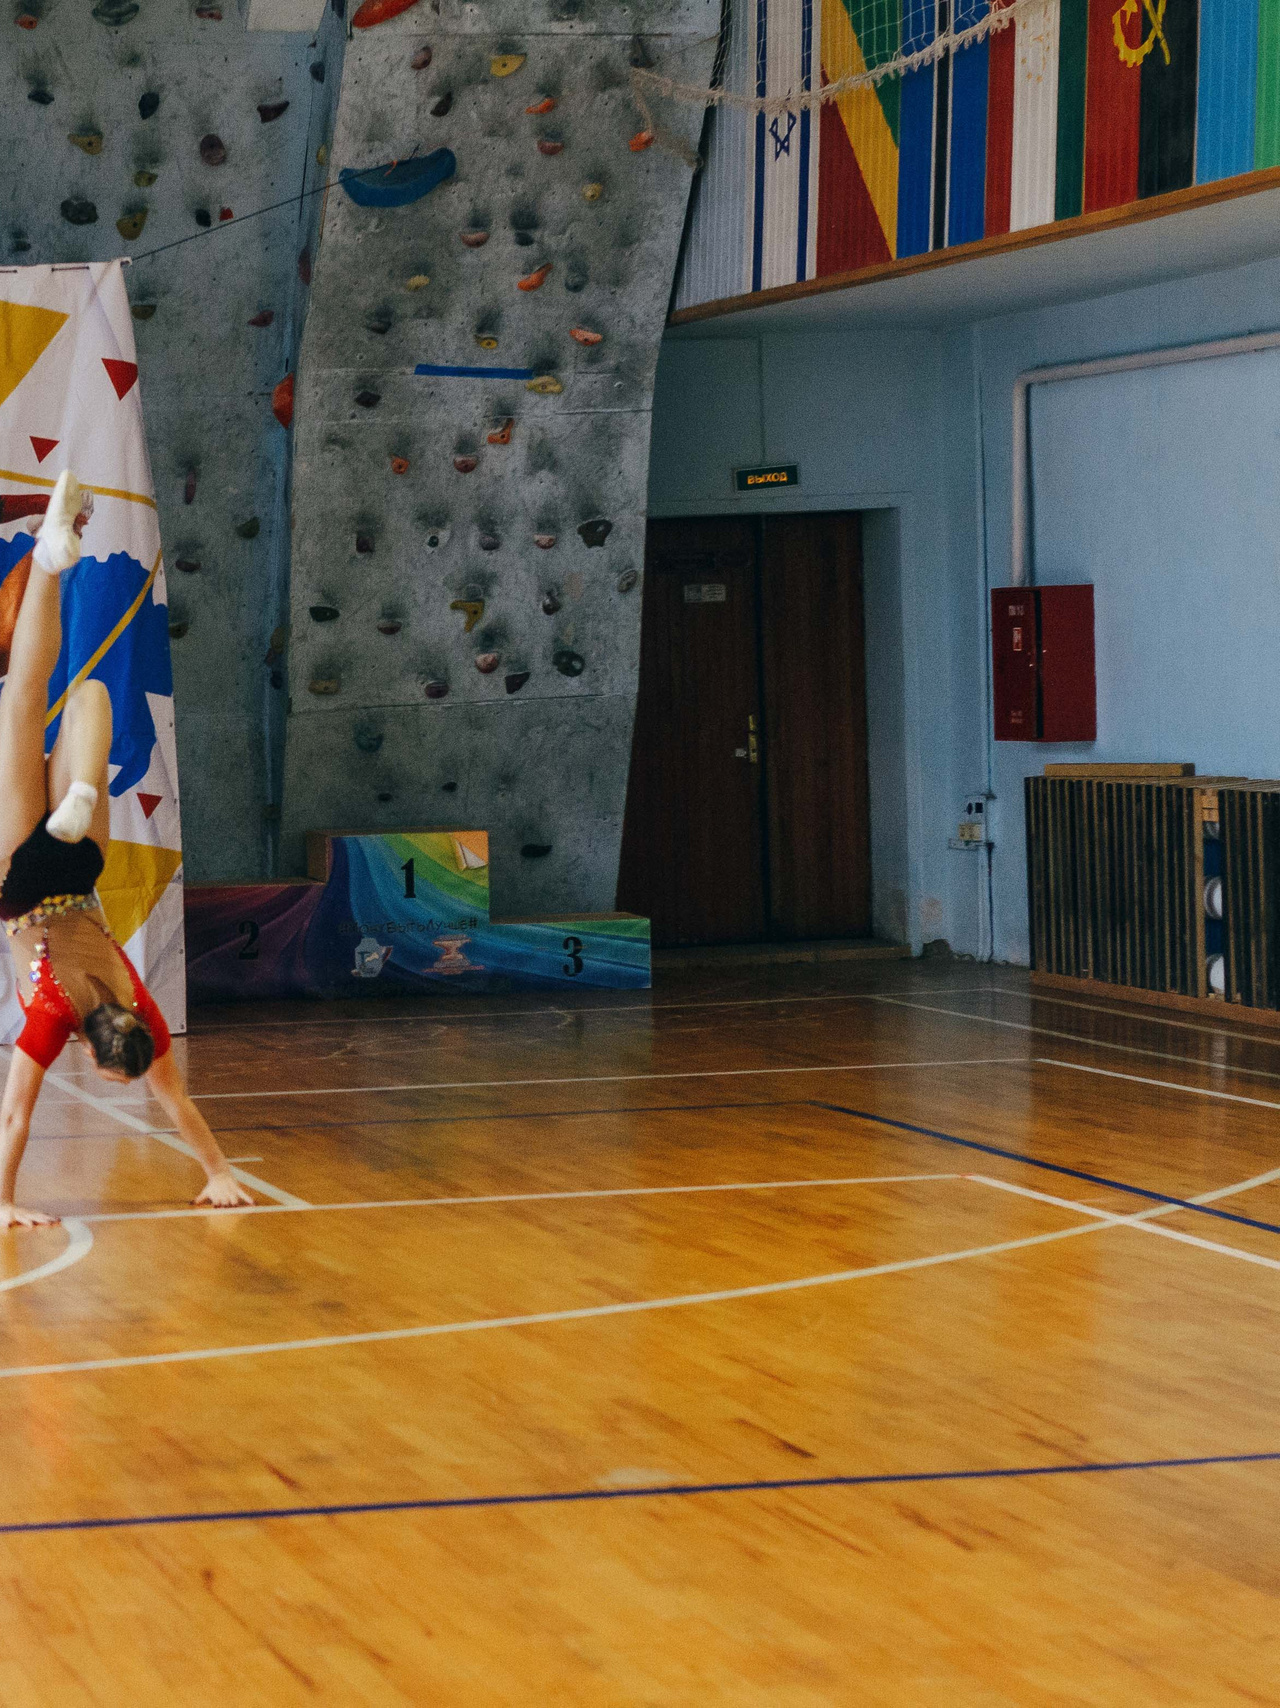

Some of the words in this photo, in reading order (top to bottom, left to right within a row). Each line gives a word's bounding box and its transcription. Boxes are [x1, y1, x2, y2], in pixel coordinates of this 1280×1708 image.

[746, 471, 788, 486] ВЫХОД
[400, 858, 417, 899] 1
[238, 920, 260, 960] 2
[562, 936, 584, 977] 3
